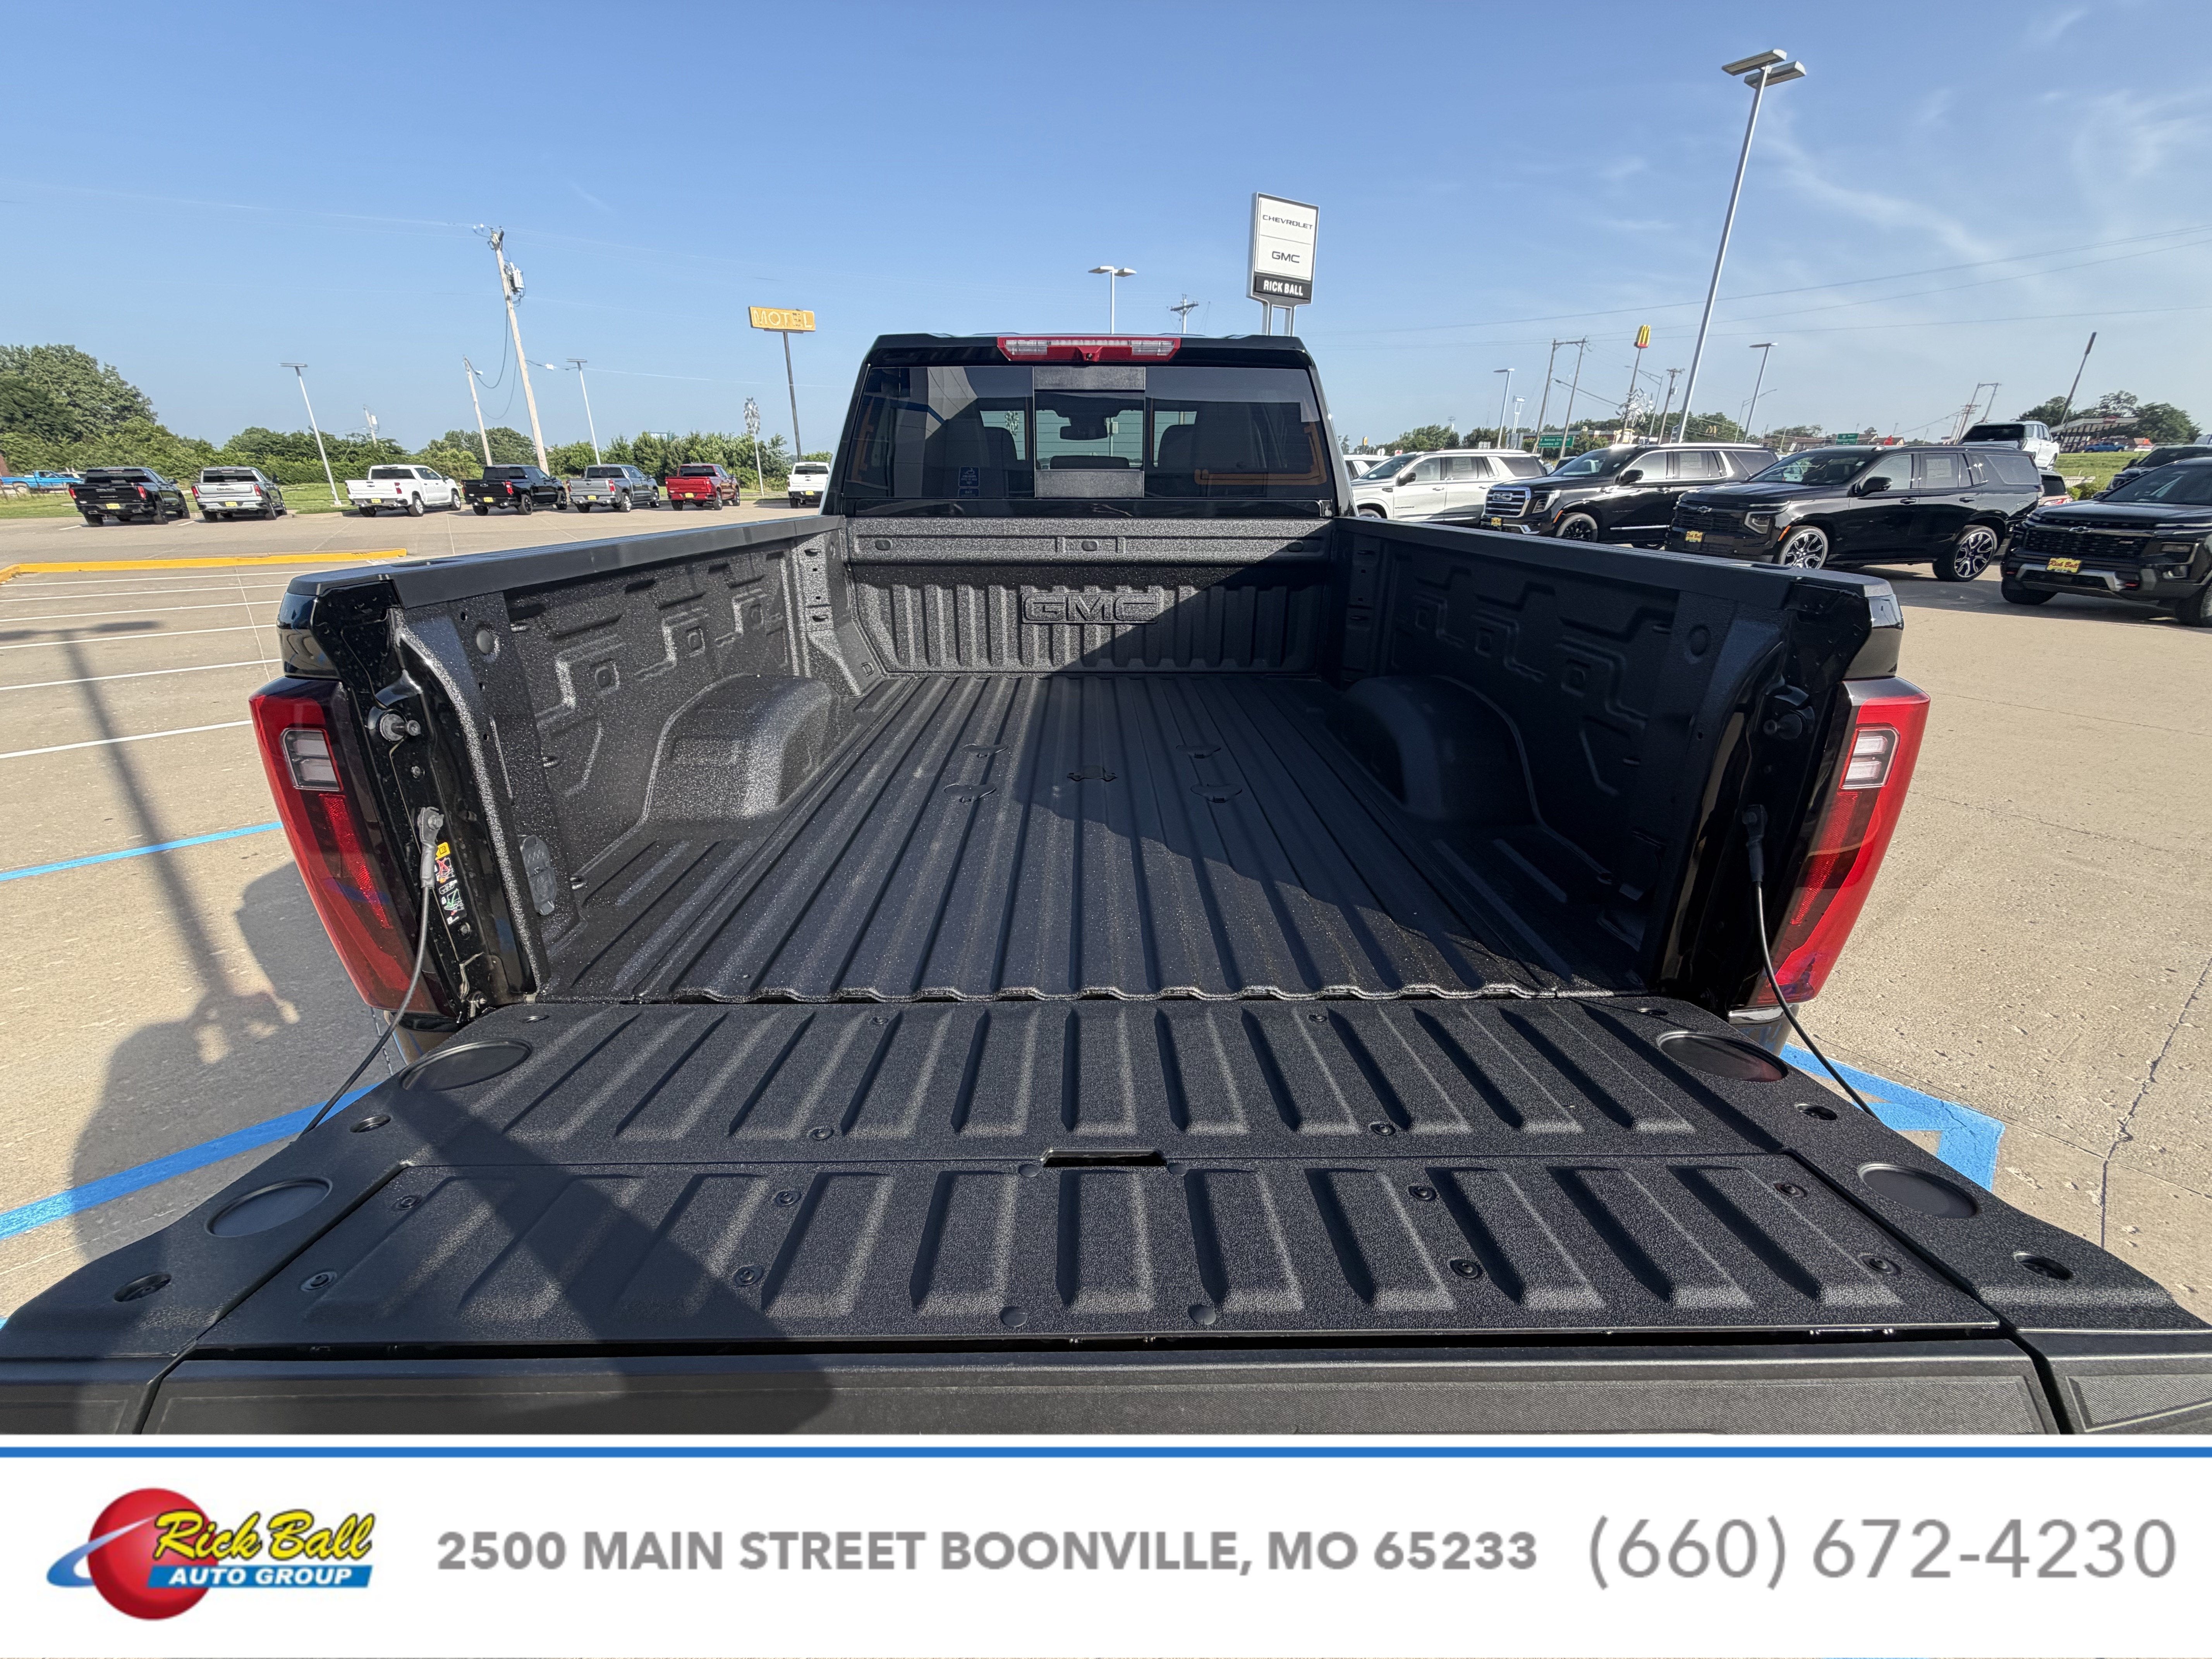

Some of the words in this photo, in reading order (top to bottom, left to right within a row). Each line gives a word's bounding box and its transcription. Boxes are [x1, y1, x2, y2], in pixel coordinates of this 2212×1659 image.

[1262, 215, 1313, 230] CHEVROLET
[1272, 251, 1300, 263] GMC
[1263, 280, 1283, 293] RICK
[1284, 283, 1304, 296] BALL
[753, 309, 812, 328] MOTEL
[1024, 595, 1157, 622] GMC
